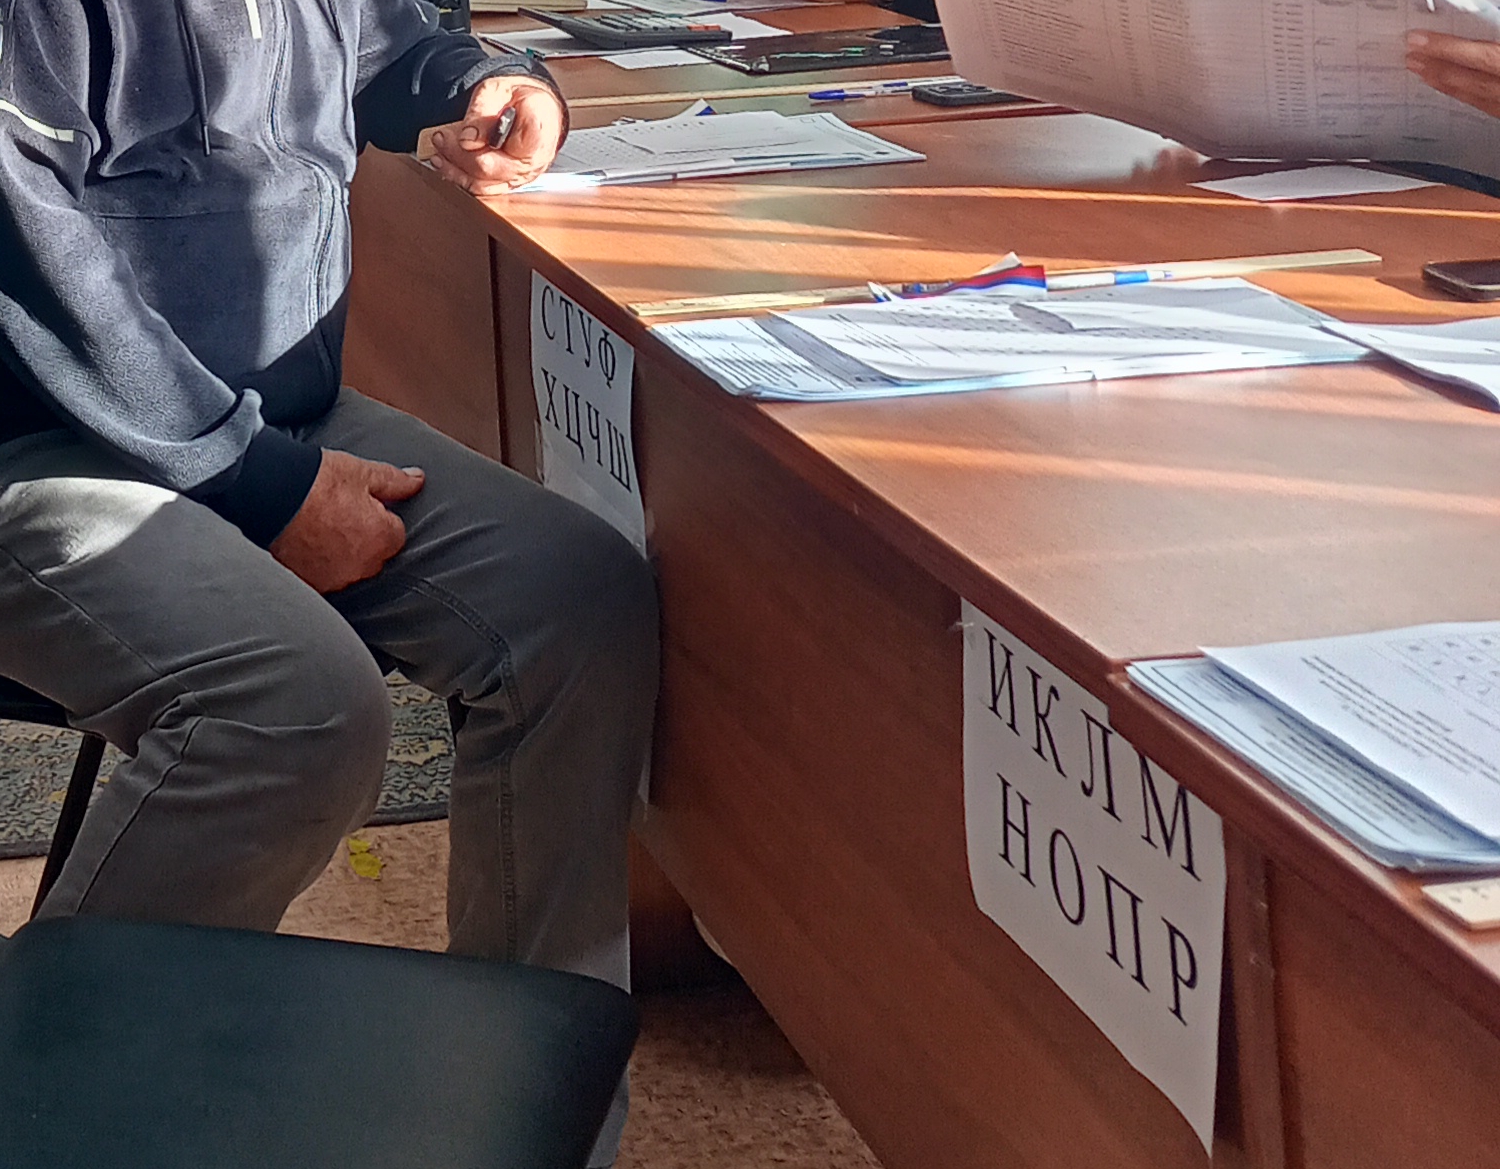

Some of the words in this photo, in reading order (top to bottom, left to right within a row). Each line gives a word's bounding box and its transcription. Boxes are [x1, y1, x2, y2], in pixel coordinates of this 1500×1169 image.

[541, 284, 617, 389] СТУФ
[541, 367, 632, 493] ХЦЧШ
[984, 628, 1202, 882] ИКЛМ
[996, 772, 1199, 1026] НОПР
